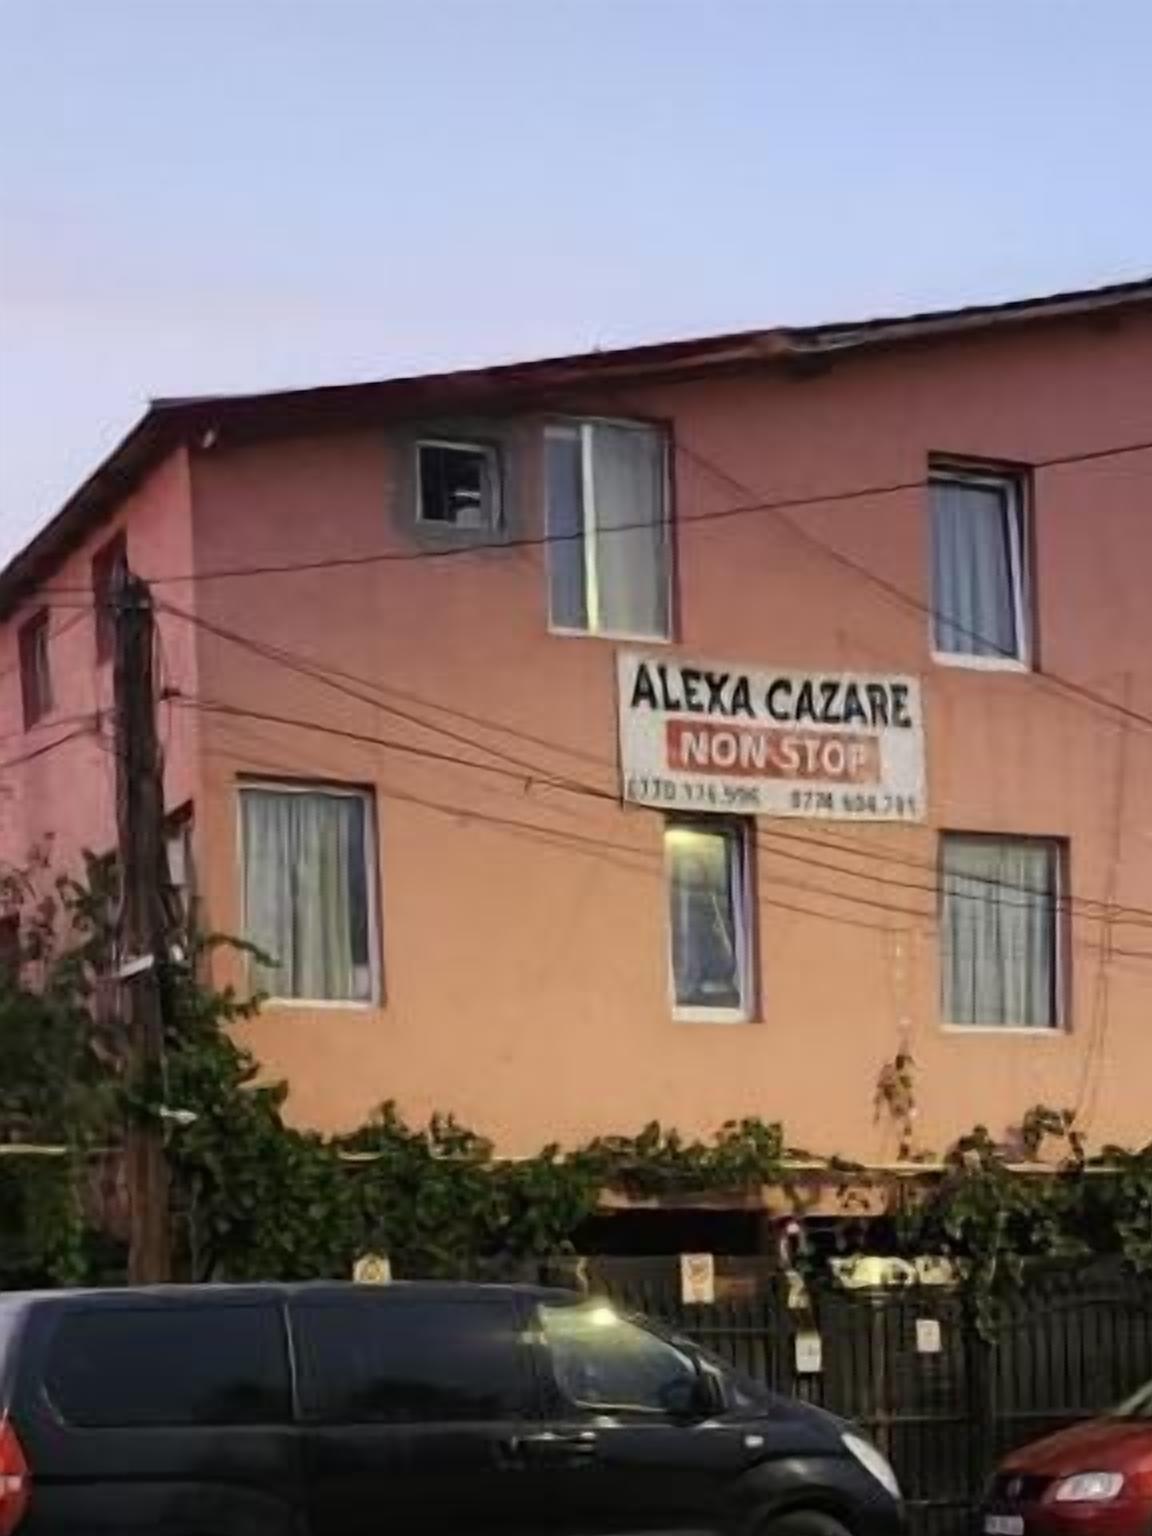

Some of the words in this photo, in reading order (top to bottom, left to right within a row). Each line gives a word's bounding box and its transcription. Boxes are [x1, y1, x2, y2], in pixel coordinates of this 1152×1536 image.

[631, 663, 756, 719] ALEXA
[765, 677, 912, 729] CAZARE
[680, 731, 766, 769] NON
[772, 737, 867, 774] STOP
